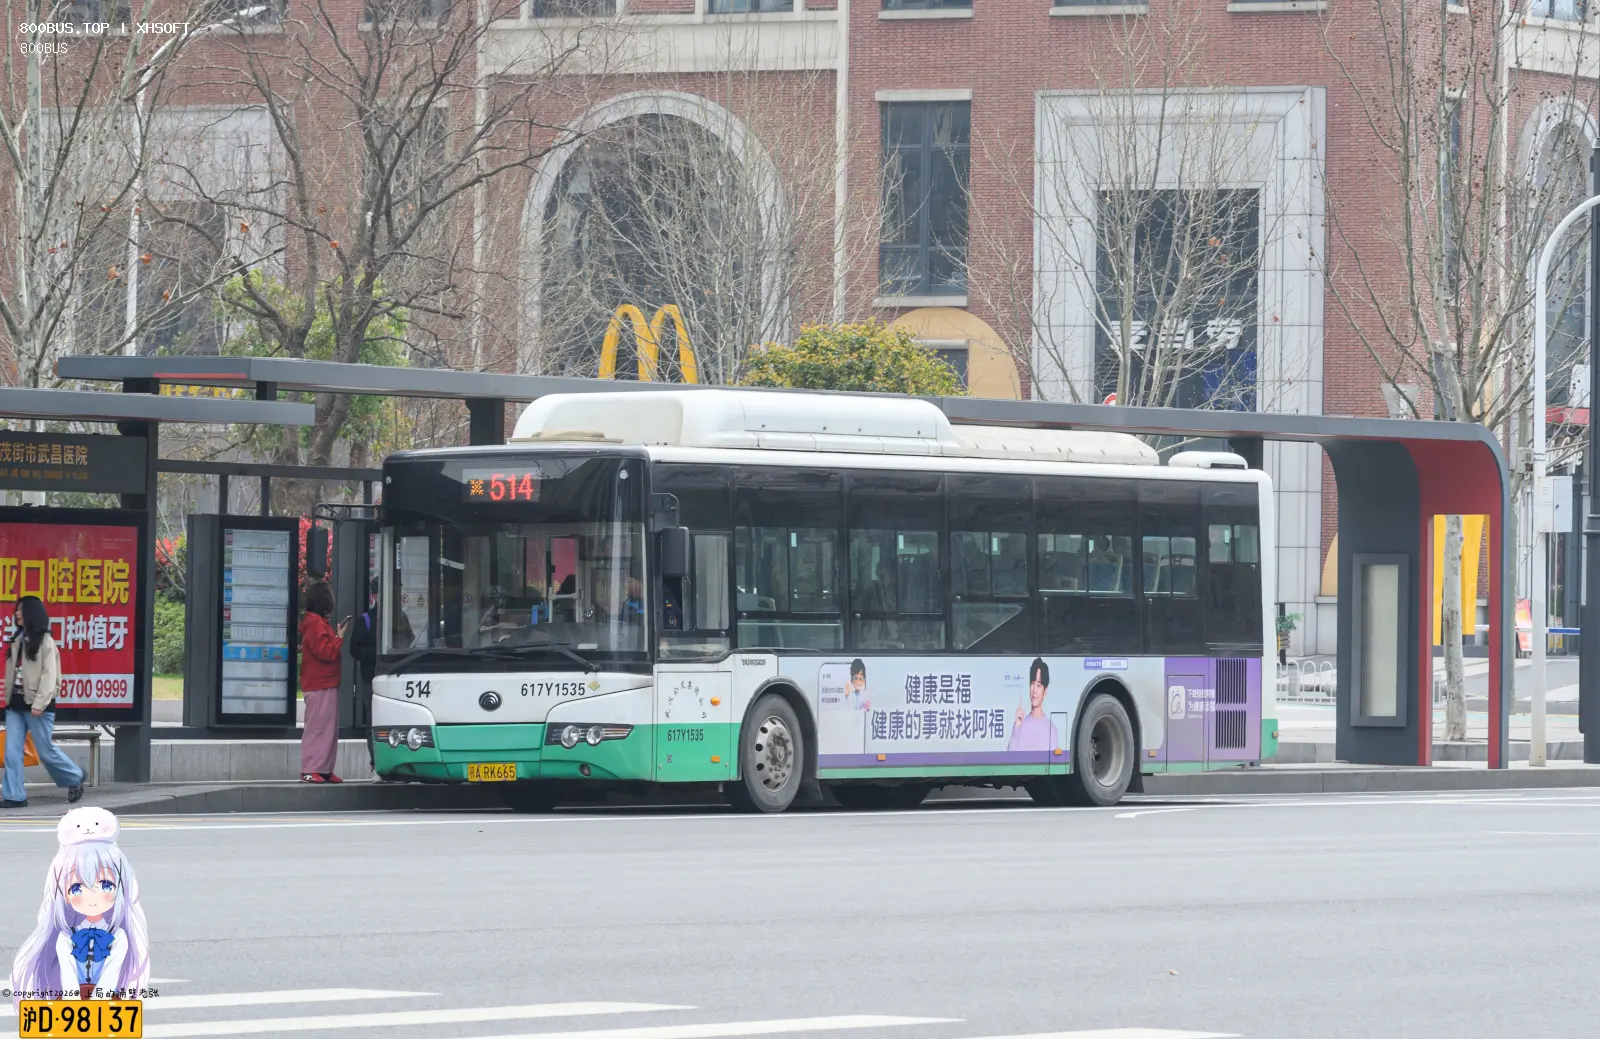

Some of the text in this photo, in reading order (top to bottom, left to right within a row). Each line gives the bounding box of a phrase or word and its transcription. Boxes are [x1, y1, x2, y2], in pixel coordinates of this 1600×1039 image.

[0, 441, 88, 466] 茂街市武昌医院
[490, 473, 534, 501] 514
[0, 557, 130, 605] 亚口腔医院
[59, 679, 127, 698] 8700 9999
[405, 680, 431, 699] 514
[520, 682, 586, 697] 617Y1535
[905, 673, 972, 705] 健康是福
[667, 729, 704, 741] 617Y1535
[871, 709, 1005, 740] 健康的事就找阿福
